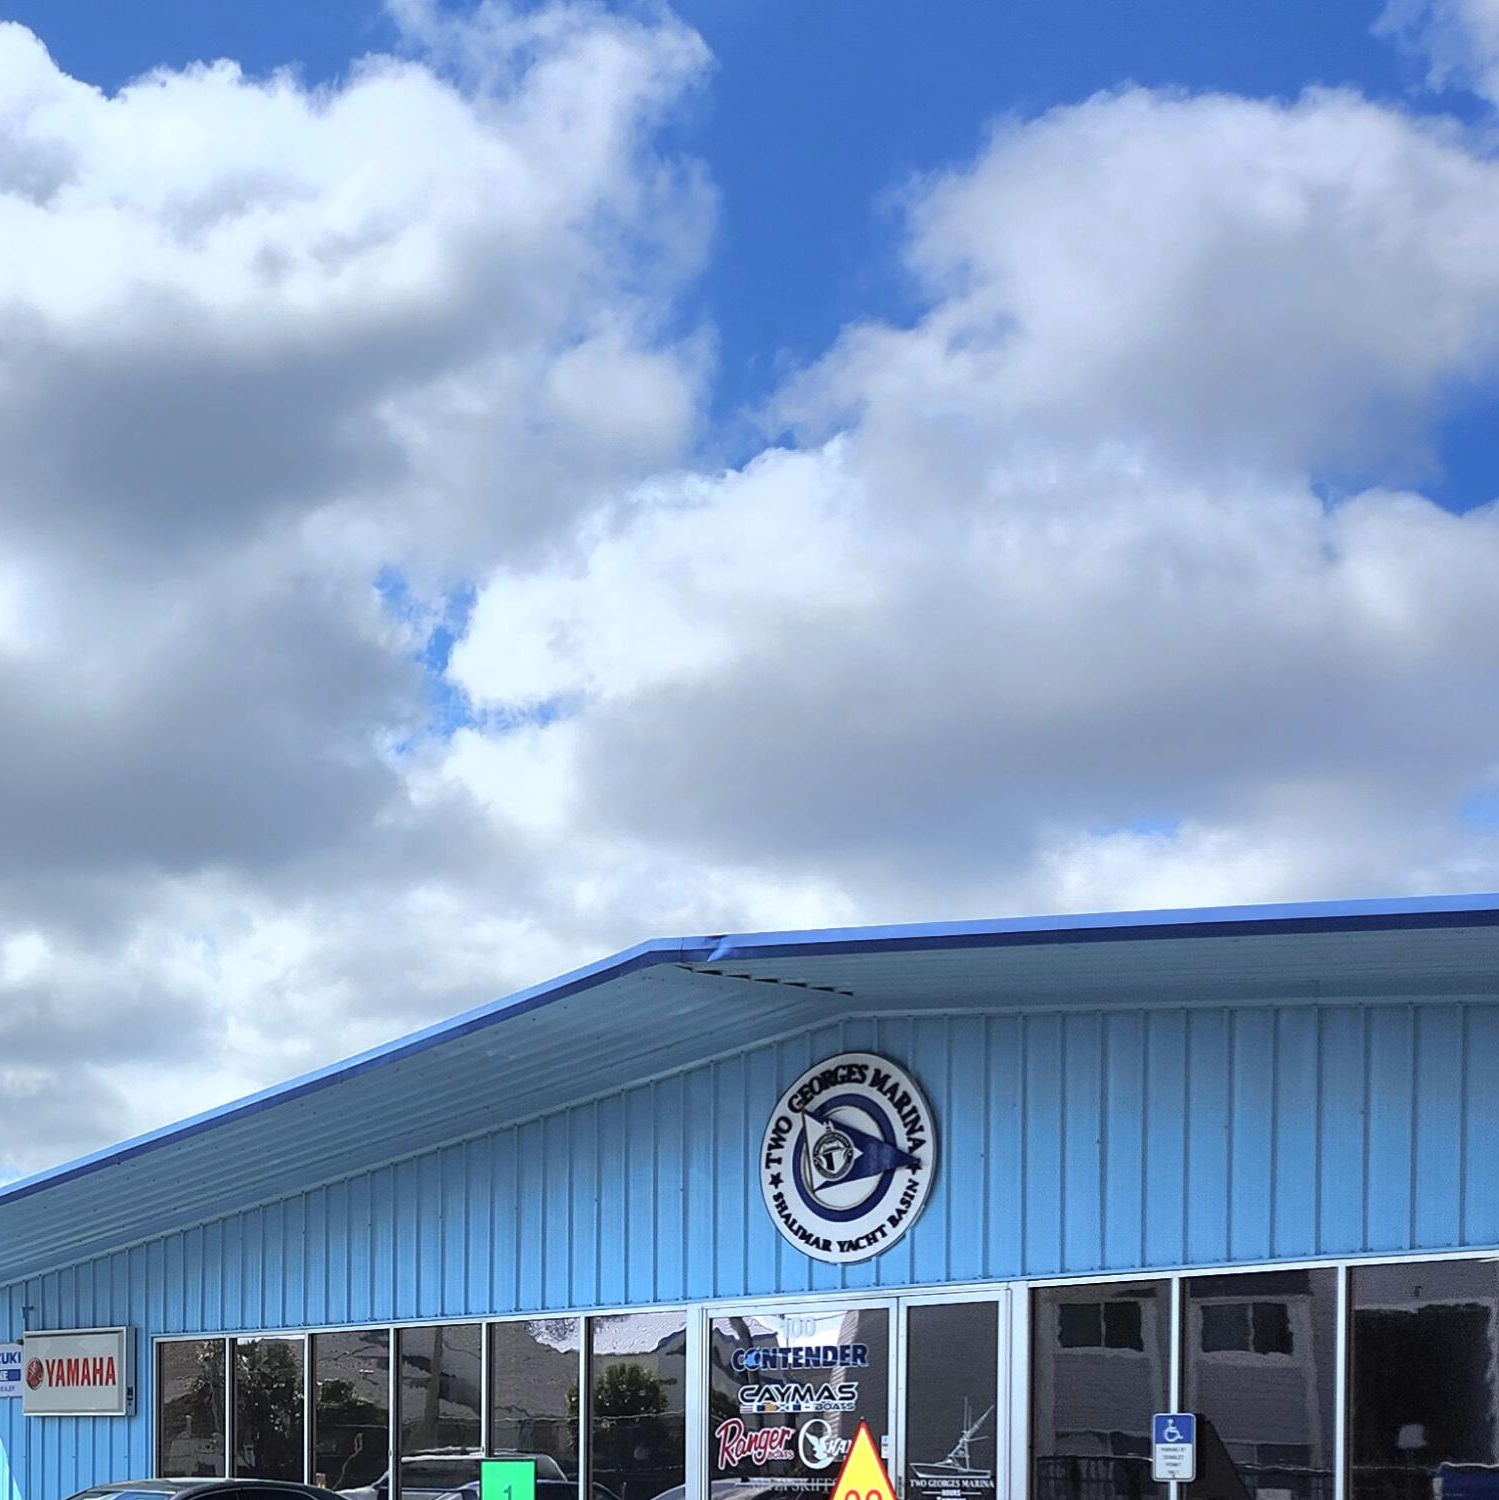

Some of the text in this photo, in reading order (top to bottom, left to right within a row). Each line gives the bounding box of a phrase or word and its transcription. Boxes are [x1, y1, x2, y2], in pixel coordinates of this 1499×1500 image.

[765, 1116, 793, 1169] TWO
[788, 1064, 869, 1114] GEORGES
[869, 1068, 927, 1154] MARINA
[772, 1178, 920, 1253] SHALIMAR YACHT BASIN
[45, 1356, 117, 1388] YAMAHA
[731, 1343, 869, 1372] CONTENDER
[738, 1382, 859, 1405] CAYMAS
[715, 1417, 796, 1471] Ranger
[909, 1480, 927, 1488] TWO
[962, 1480, 995, 1488] MARINA
